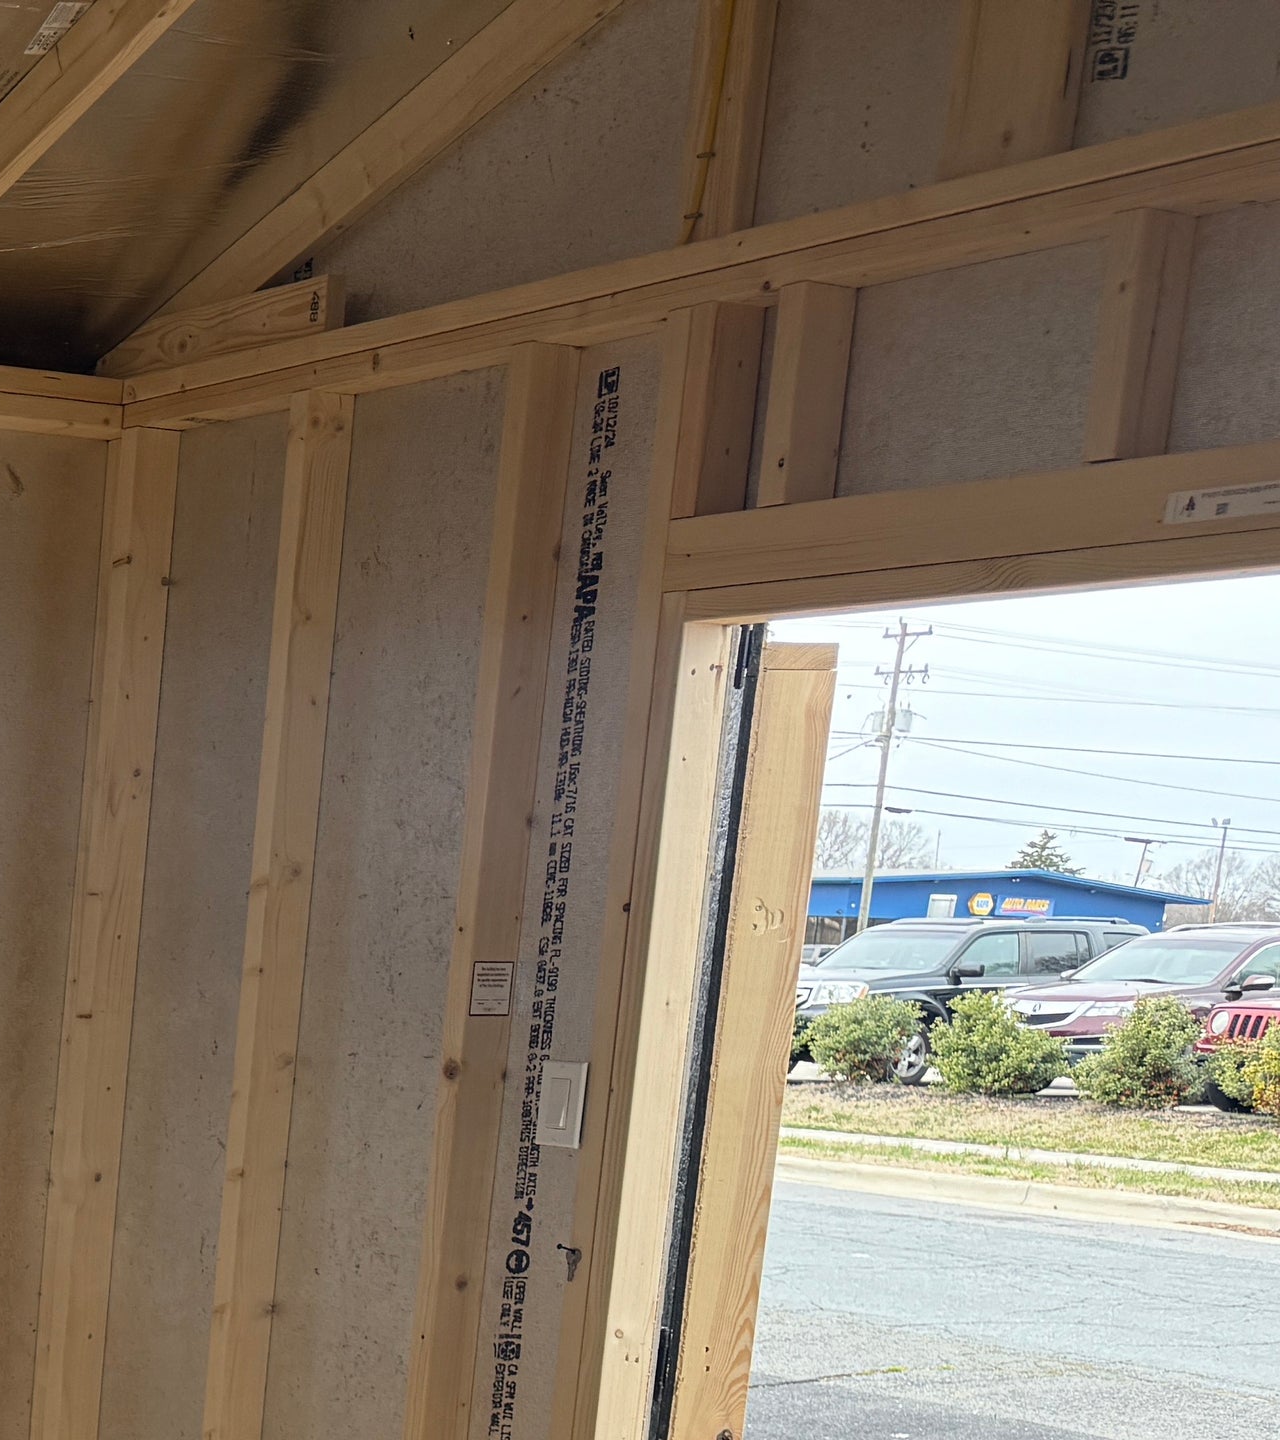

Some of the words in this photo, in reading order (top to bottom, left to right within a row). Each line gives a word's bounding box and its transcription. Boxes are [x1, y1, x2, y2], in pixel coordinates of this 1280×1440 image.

[573, 574, 599, 620] APA
[581, 620, 595, 653] RATED
[562, 818, 574, 837] CAT
[558, 842, 572, 873] SIZED
[555, 877, 568, 898] FOR
[525, 1173, 538, 1196] AXIS
[511, 1211, 532, 1247] 457
[507, 1363, 519, 1376] CA
